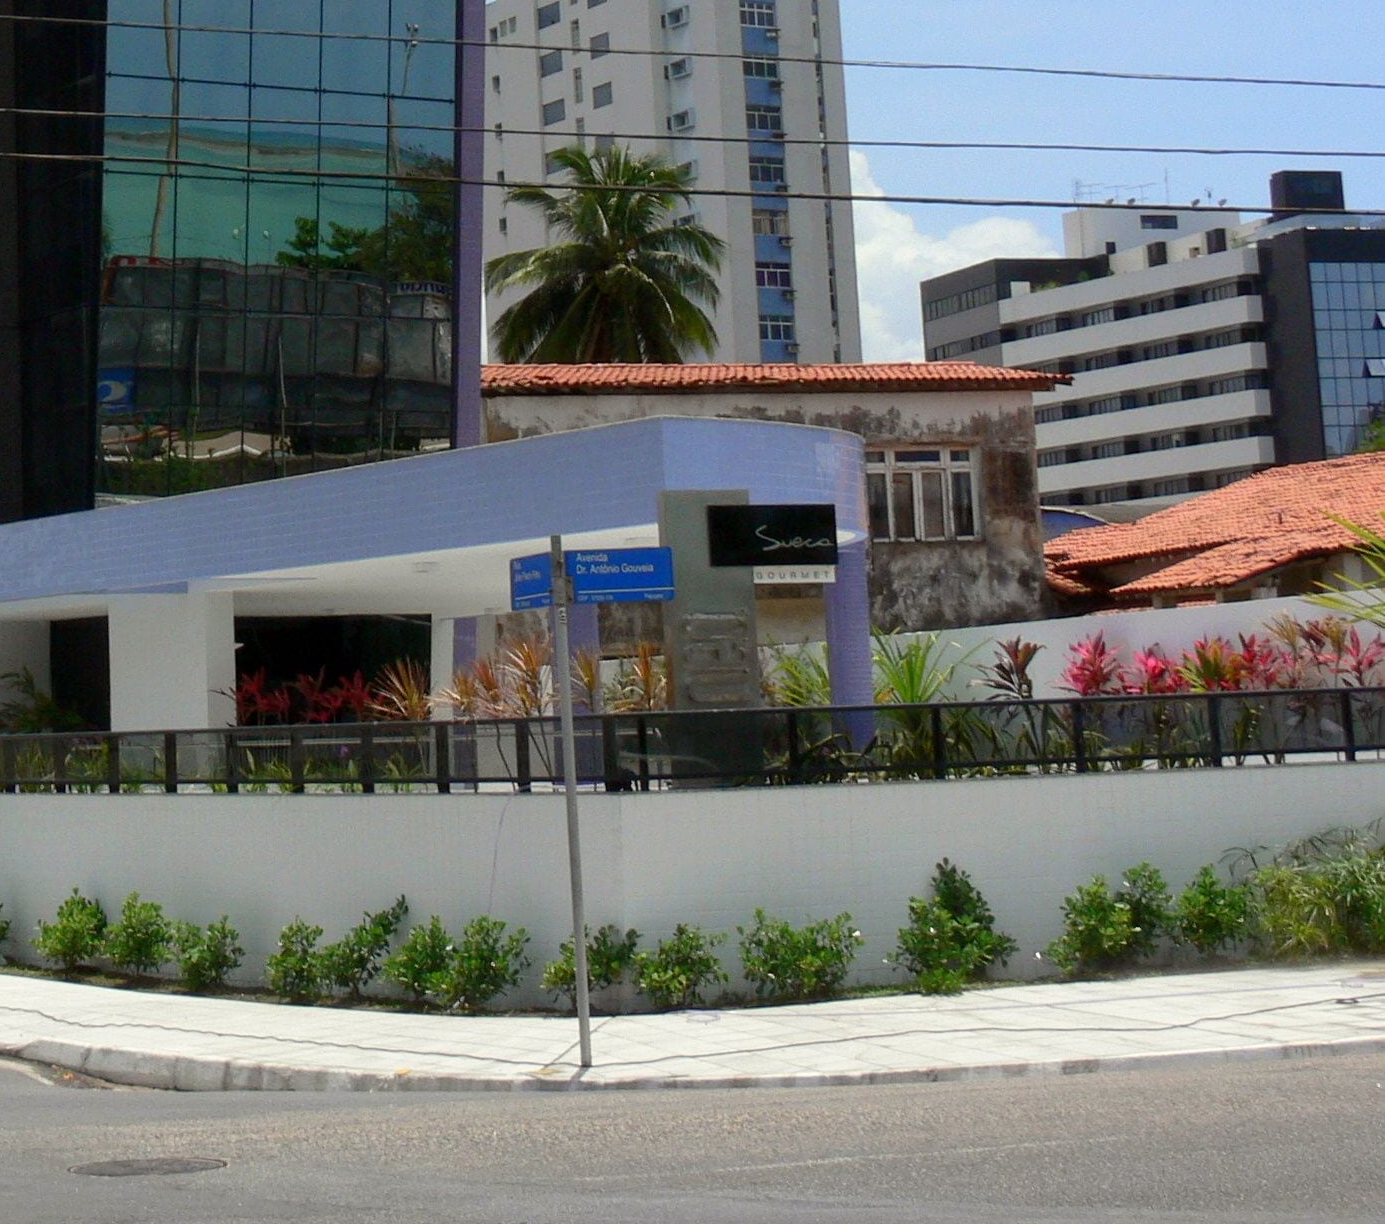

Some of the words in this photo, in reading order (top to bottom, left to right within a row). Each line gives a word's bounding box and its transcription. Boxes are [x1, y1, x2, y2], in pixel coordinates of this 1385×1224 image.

[576, 553, 608, 562] Avenida
[576, 564, 588, 574] Dr.
[589, 563, 620, 574] Antônio
[621, 562, 654, 573] Gouveia
[755, 571, 830, 580] GOURMET
